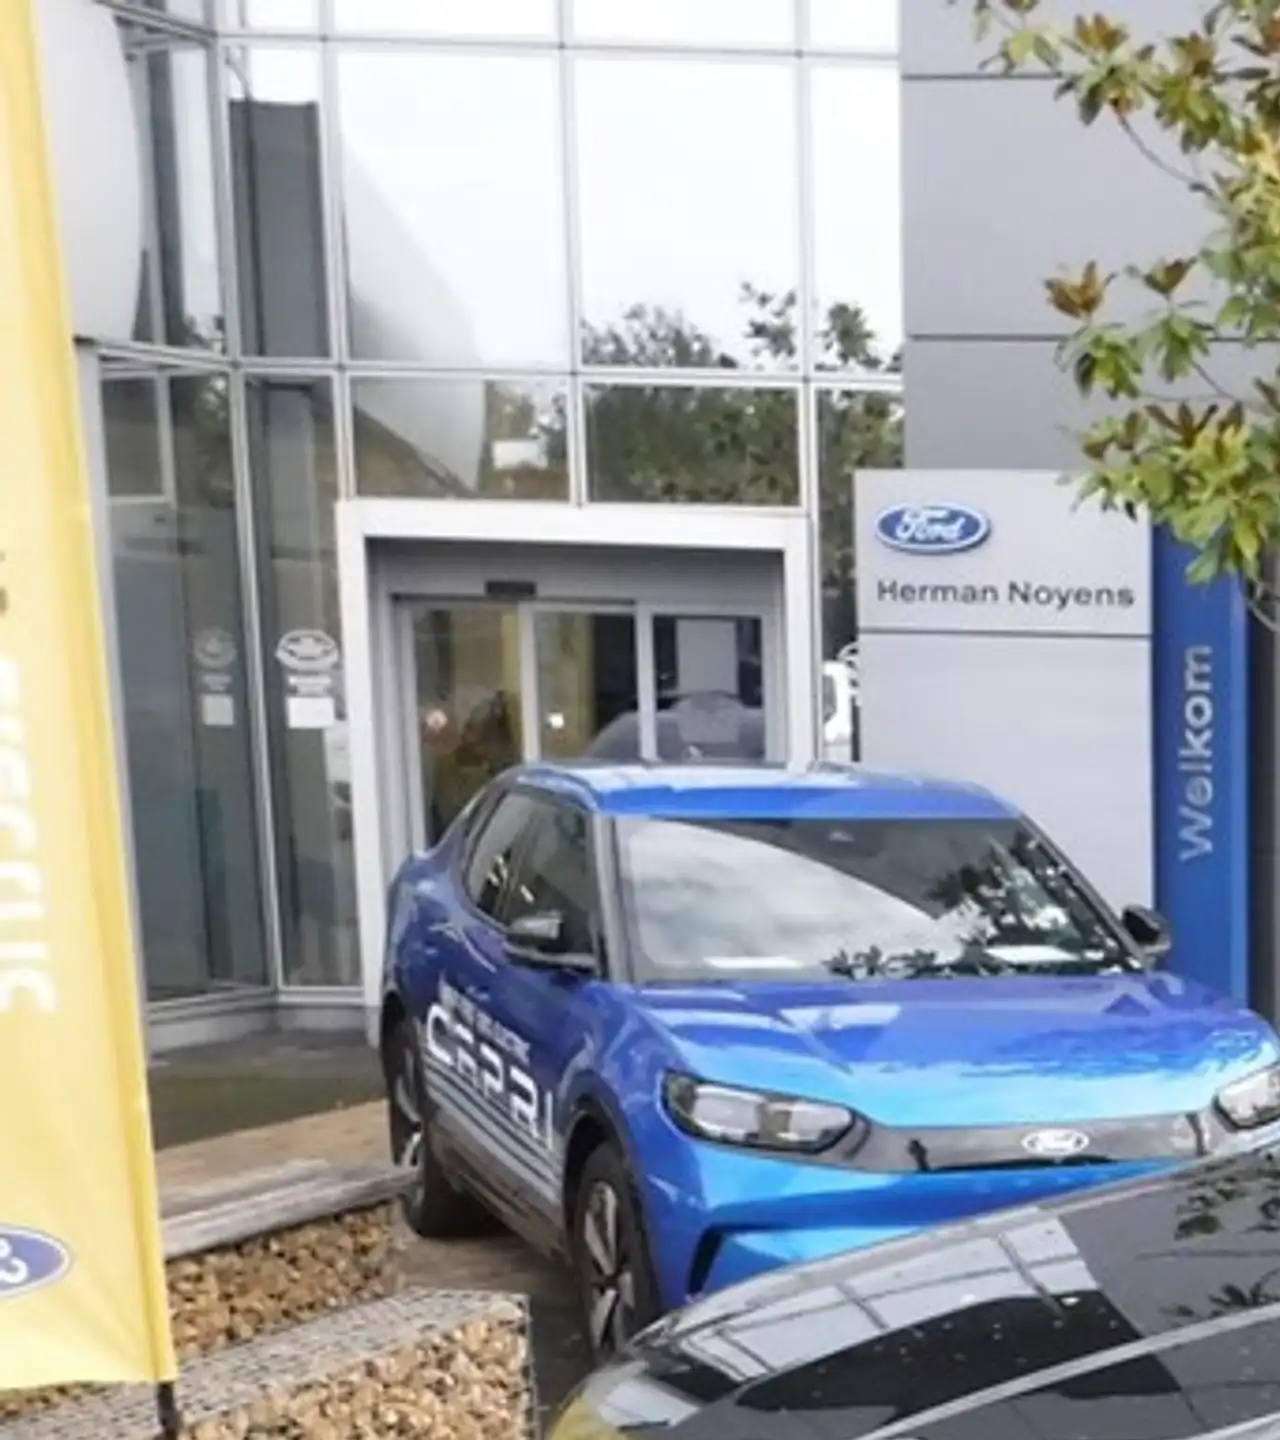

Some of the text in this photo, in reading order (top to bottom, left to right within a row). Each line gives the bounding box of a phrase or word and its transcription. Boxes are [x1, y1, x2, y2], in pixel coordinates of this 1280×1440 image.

[895, 507, 967, 543] Ford
[877, 579, 1134, 610] Herman Noyens
[1178, 645, 1213, 863] Welkom
